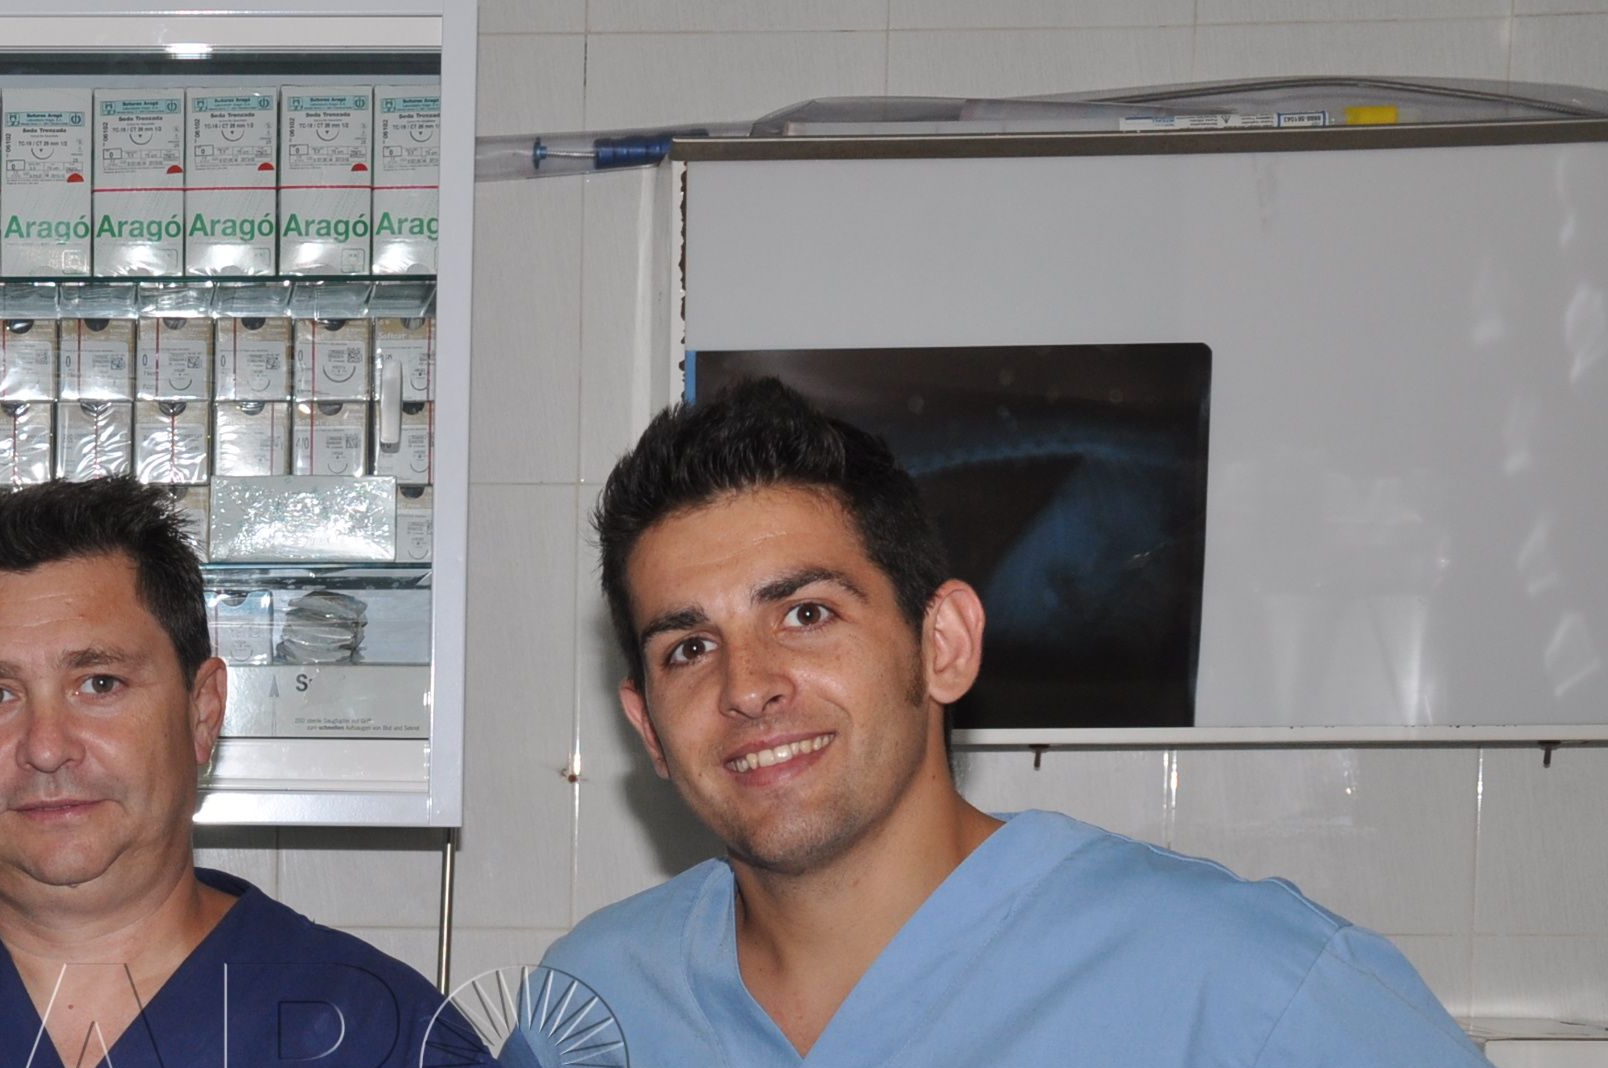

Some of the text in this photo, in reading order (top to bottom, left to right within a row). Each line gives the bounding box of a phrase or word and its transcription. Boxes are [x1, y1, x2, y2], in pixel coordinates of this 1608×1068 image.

[4, 215, 90, 244] Aragó
[96, 214, 182, 242] Aragó
[189, 213, 275, 241] Aragó
[282, 213, 369, 243] Aragó
[375, 211, 439, 241] Arag
